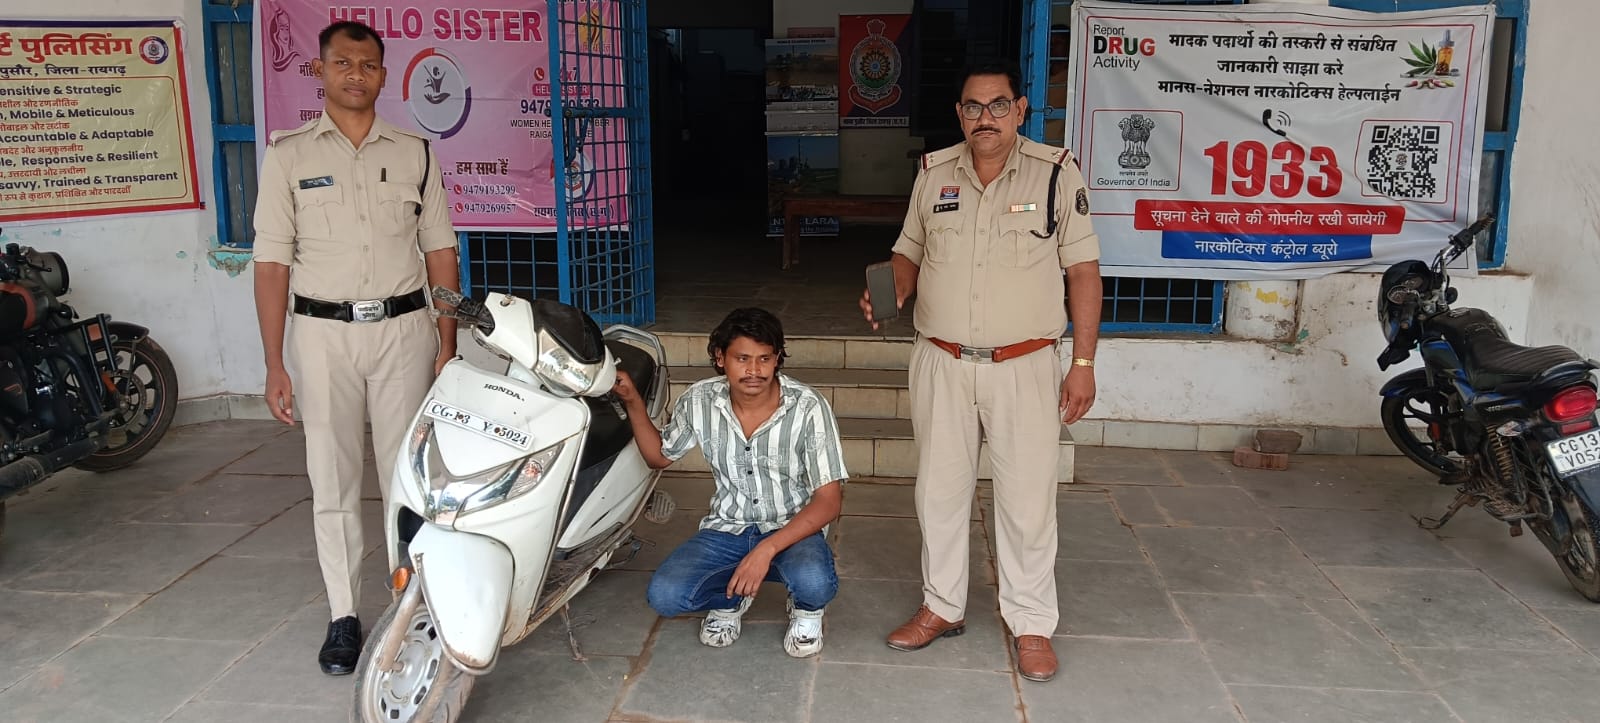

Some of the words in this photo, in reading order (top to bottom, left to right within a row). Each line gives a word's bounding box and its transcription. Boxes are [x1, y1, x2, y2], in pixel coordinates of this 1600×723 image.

[433, 8, 543, 42] SISTER
[1093, 24, 1125, 36] Report
[19, 32, 133, 63] पुलिसिंग
[1093, 36, 1156, 57] DRUG
[1169, 34, 1208, 47] मादक
[1258, 30, 1278, 49] की
[1282, 33, 1327, 50] तस्करी
[1330, 34, 1344, 51] से
[1092, 56, 1140, 72] Activity
[1216, 56, 1279, 74] जानकारी
[1282, 60, 1319, 77] साझा
[1323, 59, 1344, 76] करे
[53, 86, 63, 95] &
[65, 84, 122, 97] Strategic
[1253, 81, 1335, 100] नारकोटिक्स
[1337, 83, 1401, 103] हेल्पलाईन
[10, 109, 53, 119] Mobile
[67, 107, 135, 118] Meticulous
[510, 119, 540, 128] WOMEN
[79, 131, 89, 140] &
[91, 128, 154, 141] Adaptable
[22, 153, 94, 167] Responsive
[96, 153, 106, 161] &
[108, 150, 159, 161] Resilient
[455, 161, 473, 175] हम
[1203, 140, 1343, 199] 1933
[43, 176, 91, 188] Trained
[93, 176, 103, 185] &
[105, 172, 178, 184] Transparent
[1097, 177, 1136, 186] Governor
[1138, 178, 1149, 186] Of
[1151, 178, 1171, 187] India
[463, 184, 517, 195] 9479193299
[464, 202, 517, 213] 9479269957
[1151, 210, 1186, 227] सूचना
[1191, 207, 1210, 224] देने
[1215, 208, 1241, 225] वाले
[1245, 209, 1263, 225] की
[1268, 209, 1314, 226] गोपनीय
[1319, 210, 1343, 226] रखी
[1347, 210, 1388, 227] जायेगी
[1195, 238, 1267, 255] नारकोटिक्स
[1271, 239, 1308, 260] कंट्रोल
[1312, 239, 1339, 260] ब्यूरो
[484, 383, 521, 400] HONDA
[483, 421, 493, 432] Y
[499, 427, 528, 445] 5024
